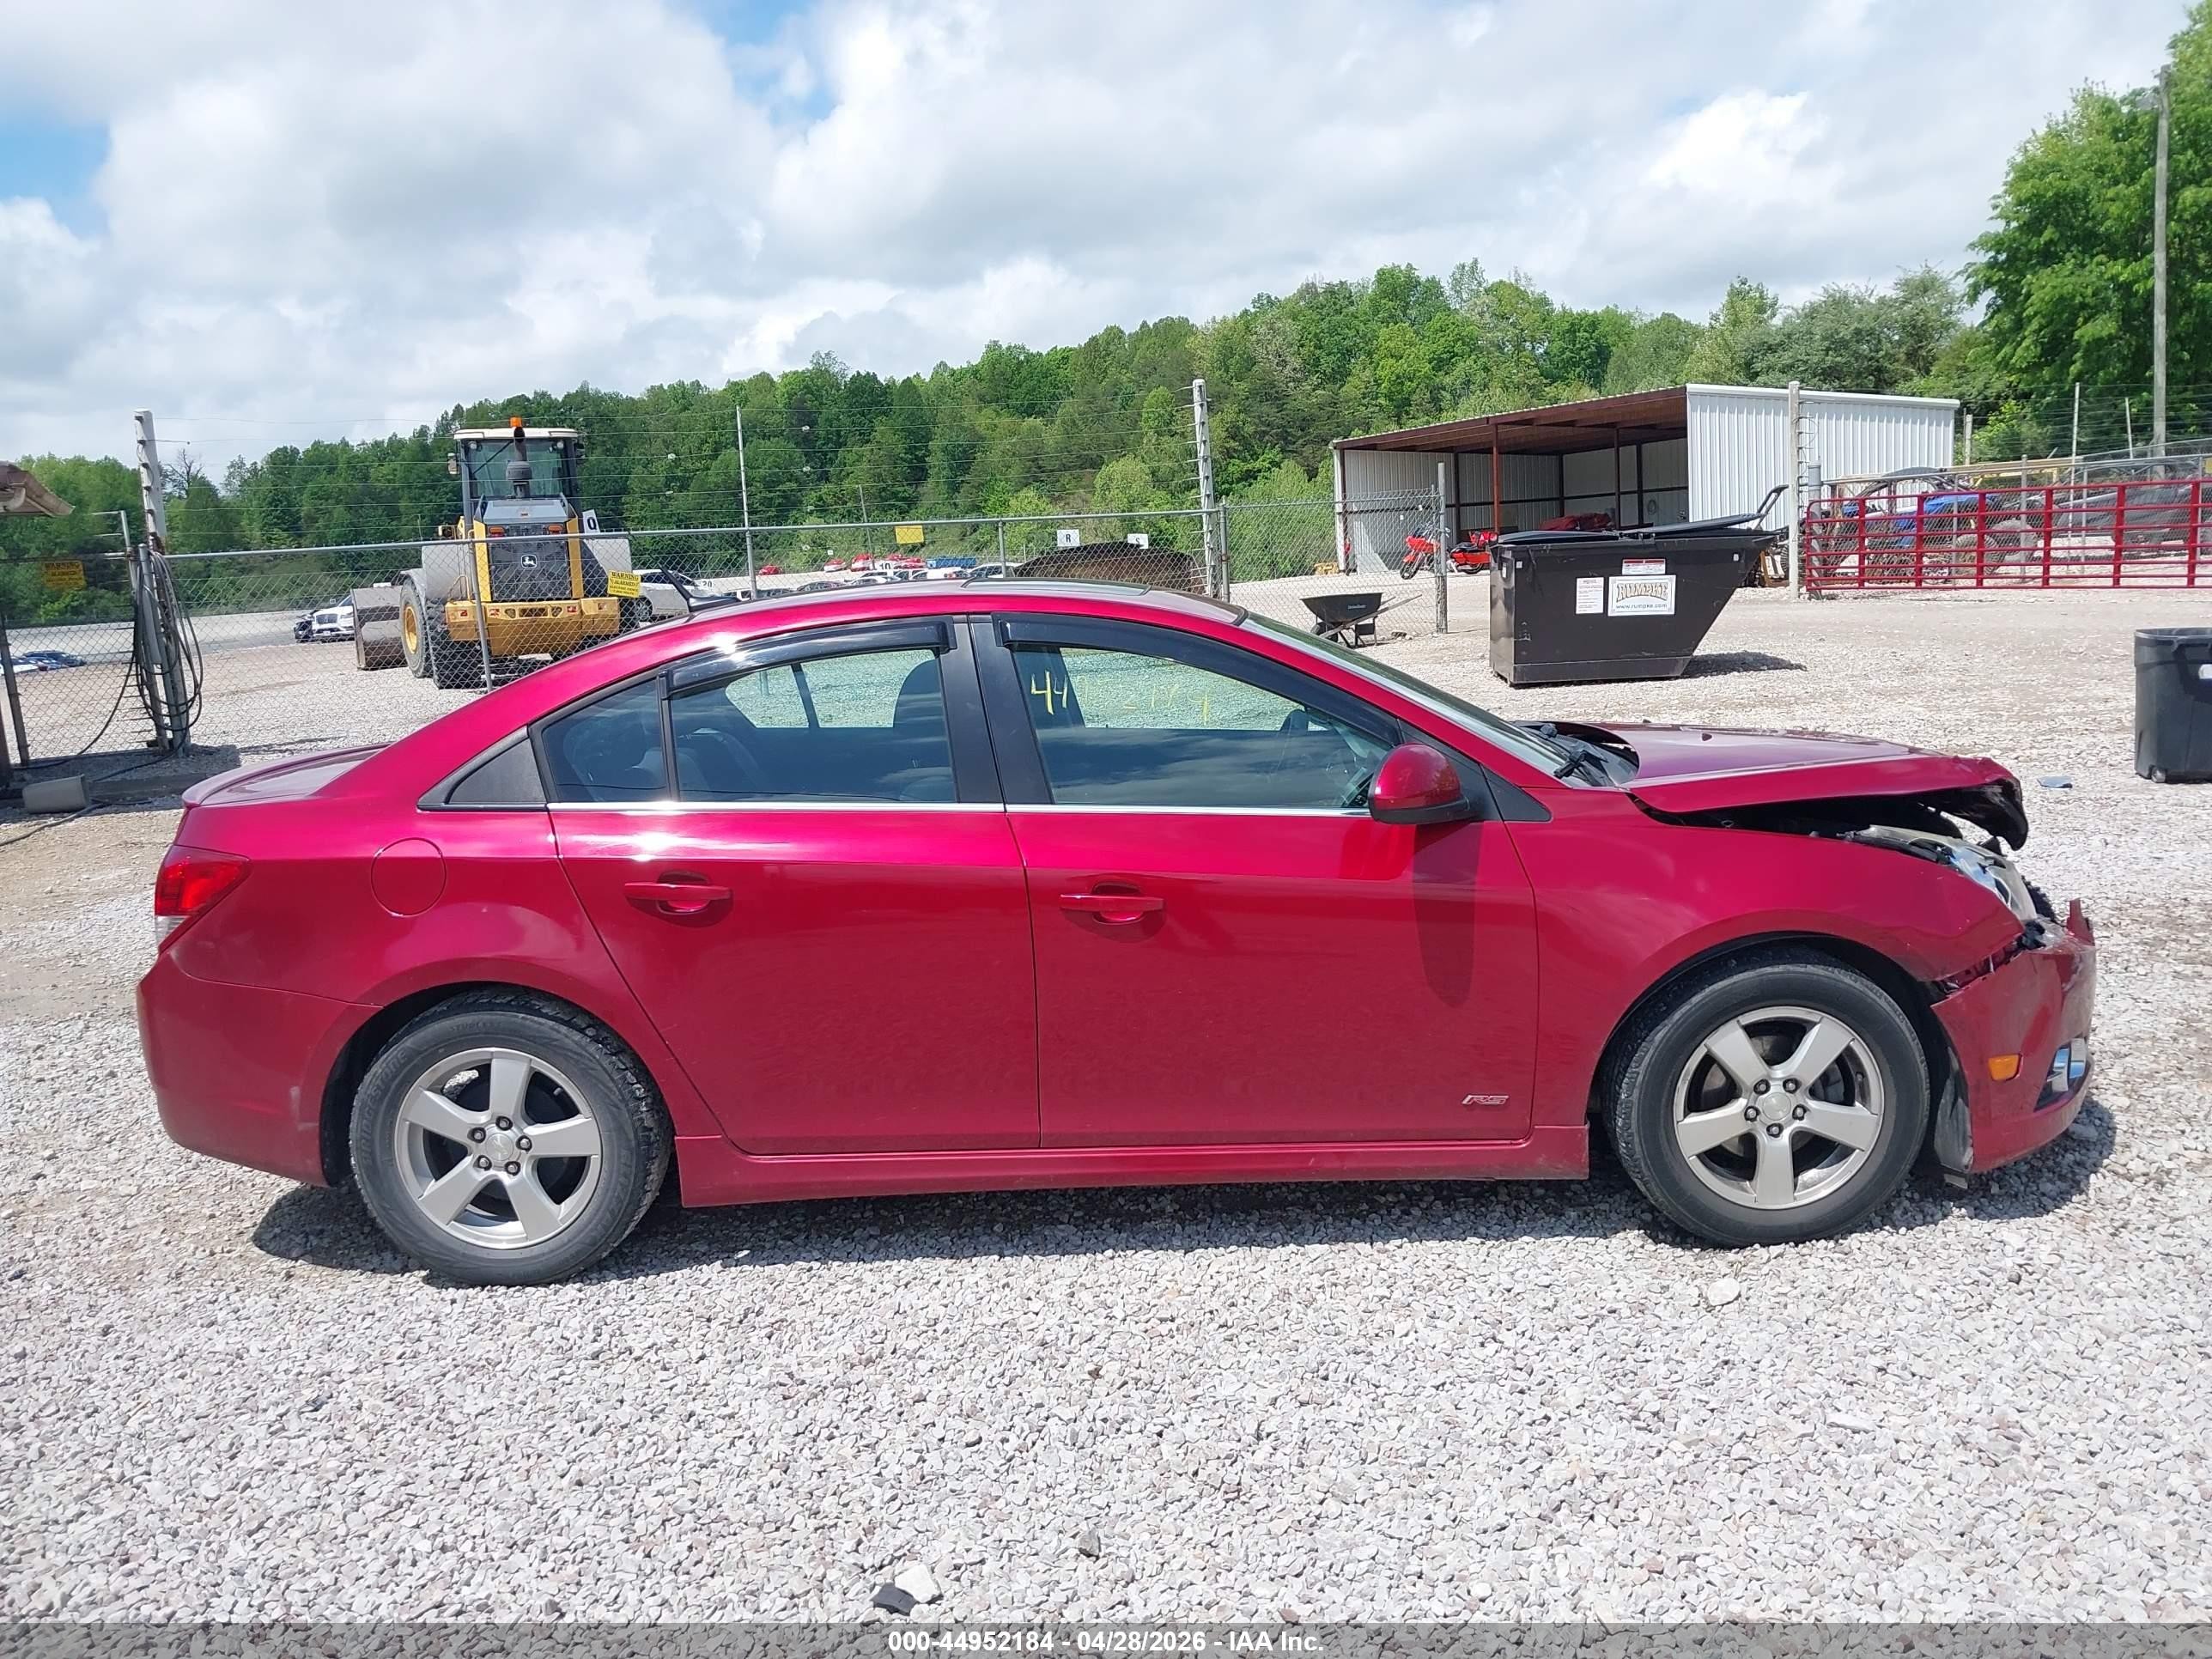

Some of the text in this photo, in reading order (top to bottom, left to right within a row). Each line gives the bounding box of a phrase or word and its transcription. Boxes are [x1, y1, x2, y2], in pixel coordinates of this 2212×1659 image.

[1065, 533, 1072, 543] R
[611, 572, 639, 581] WARNING
[1616, 581, 1668, 603] RUMPKE
[1462, 1094, 1510, 1106] RS
